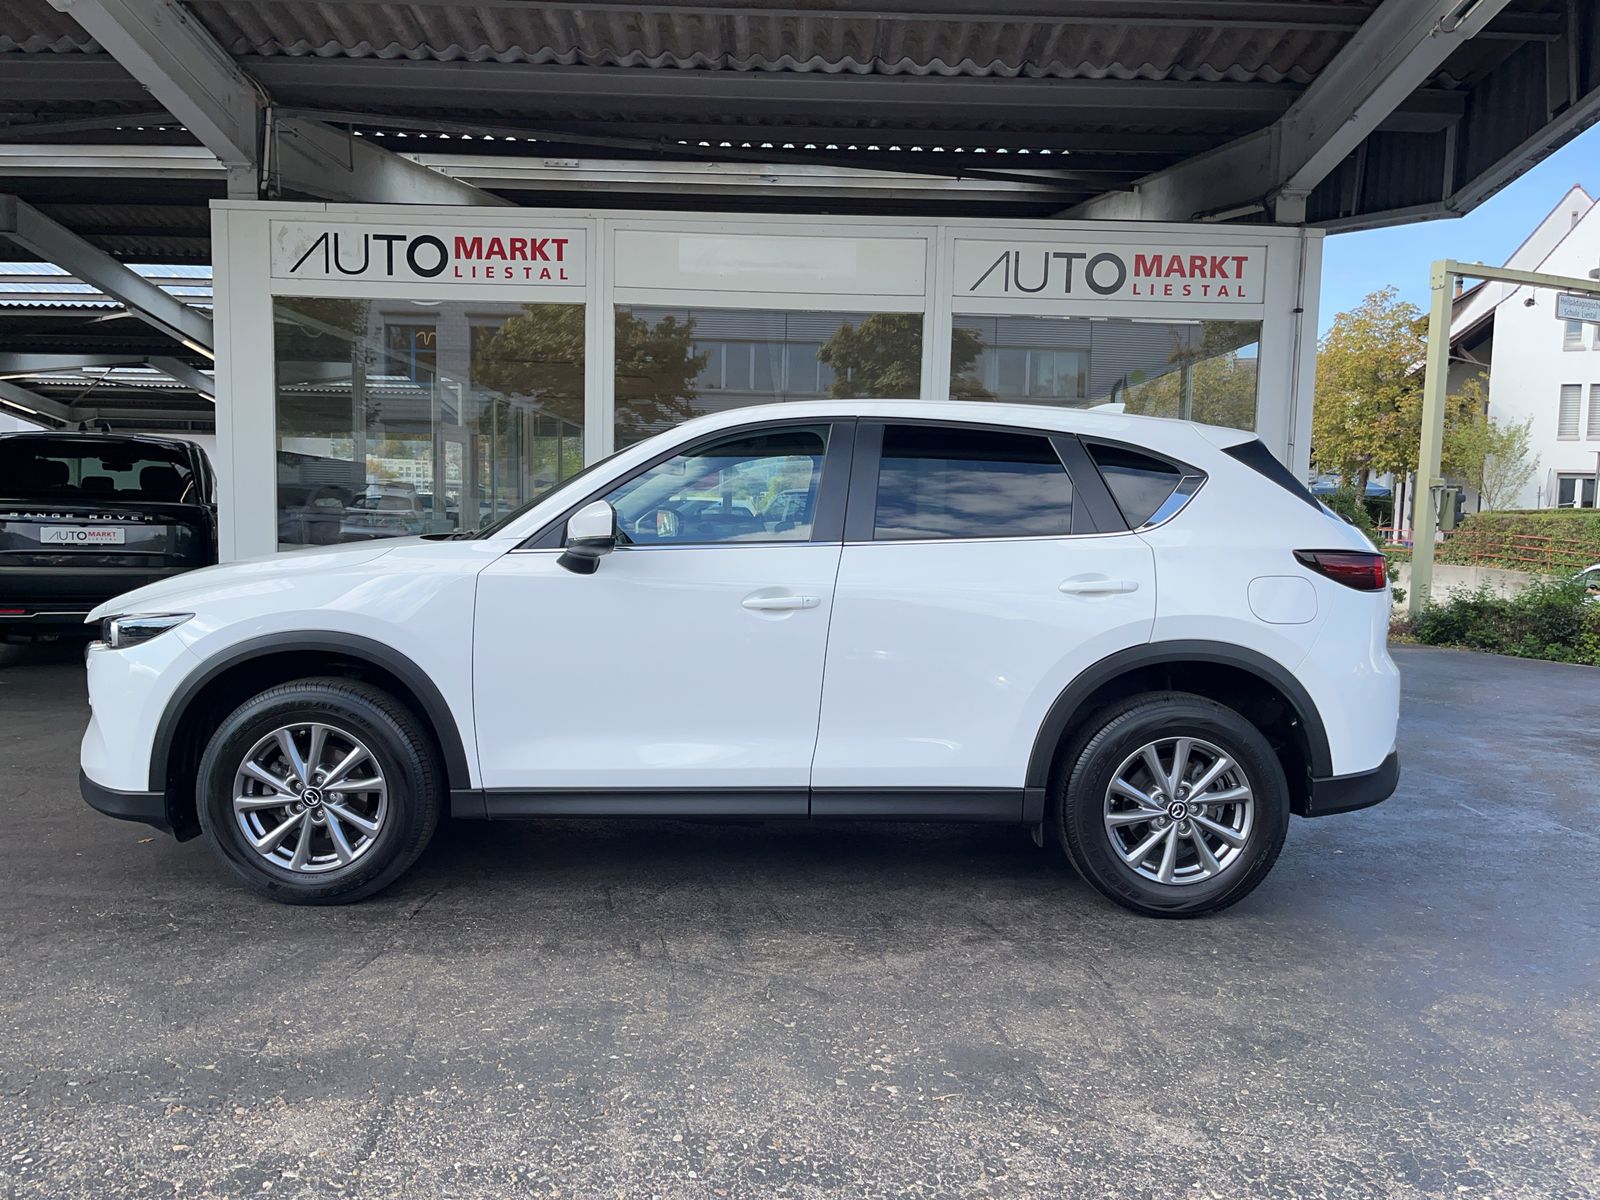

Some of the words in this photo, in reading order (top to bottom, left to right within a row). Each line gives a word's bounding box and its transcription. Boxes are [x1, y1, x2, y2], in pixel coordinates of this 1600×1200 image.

[289, 232, 448, 278] AUTO
[454, 235, 568, 262] MARKT
[454, 265, 568, 280] LIESTAL
[969, 250, 1127, 295] AUTO
[1134, 253, 1248, 279] MARKT
[1132, 283, 1246, 298] LIESTAL
[49, 531, 87, 541] AUTO
